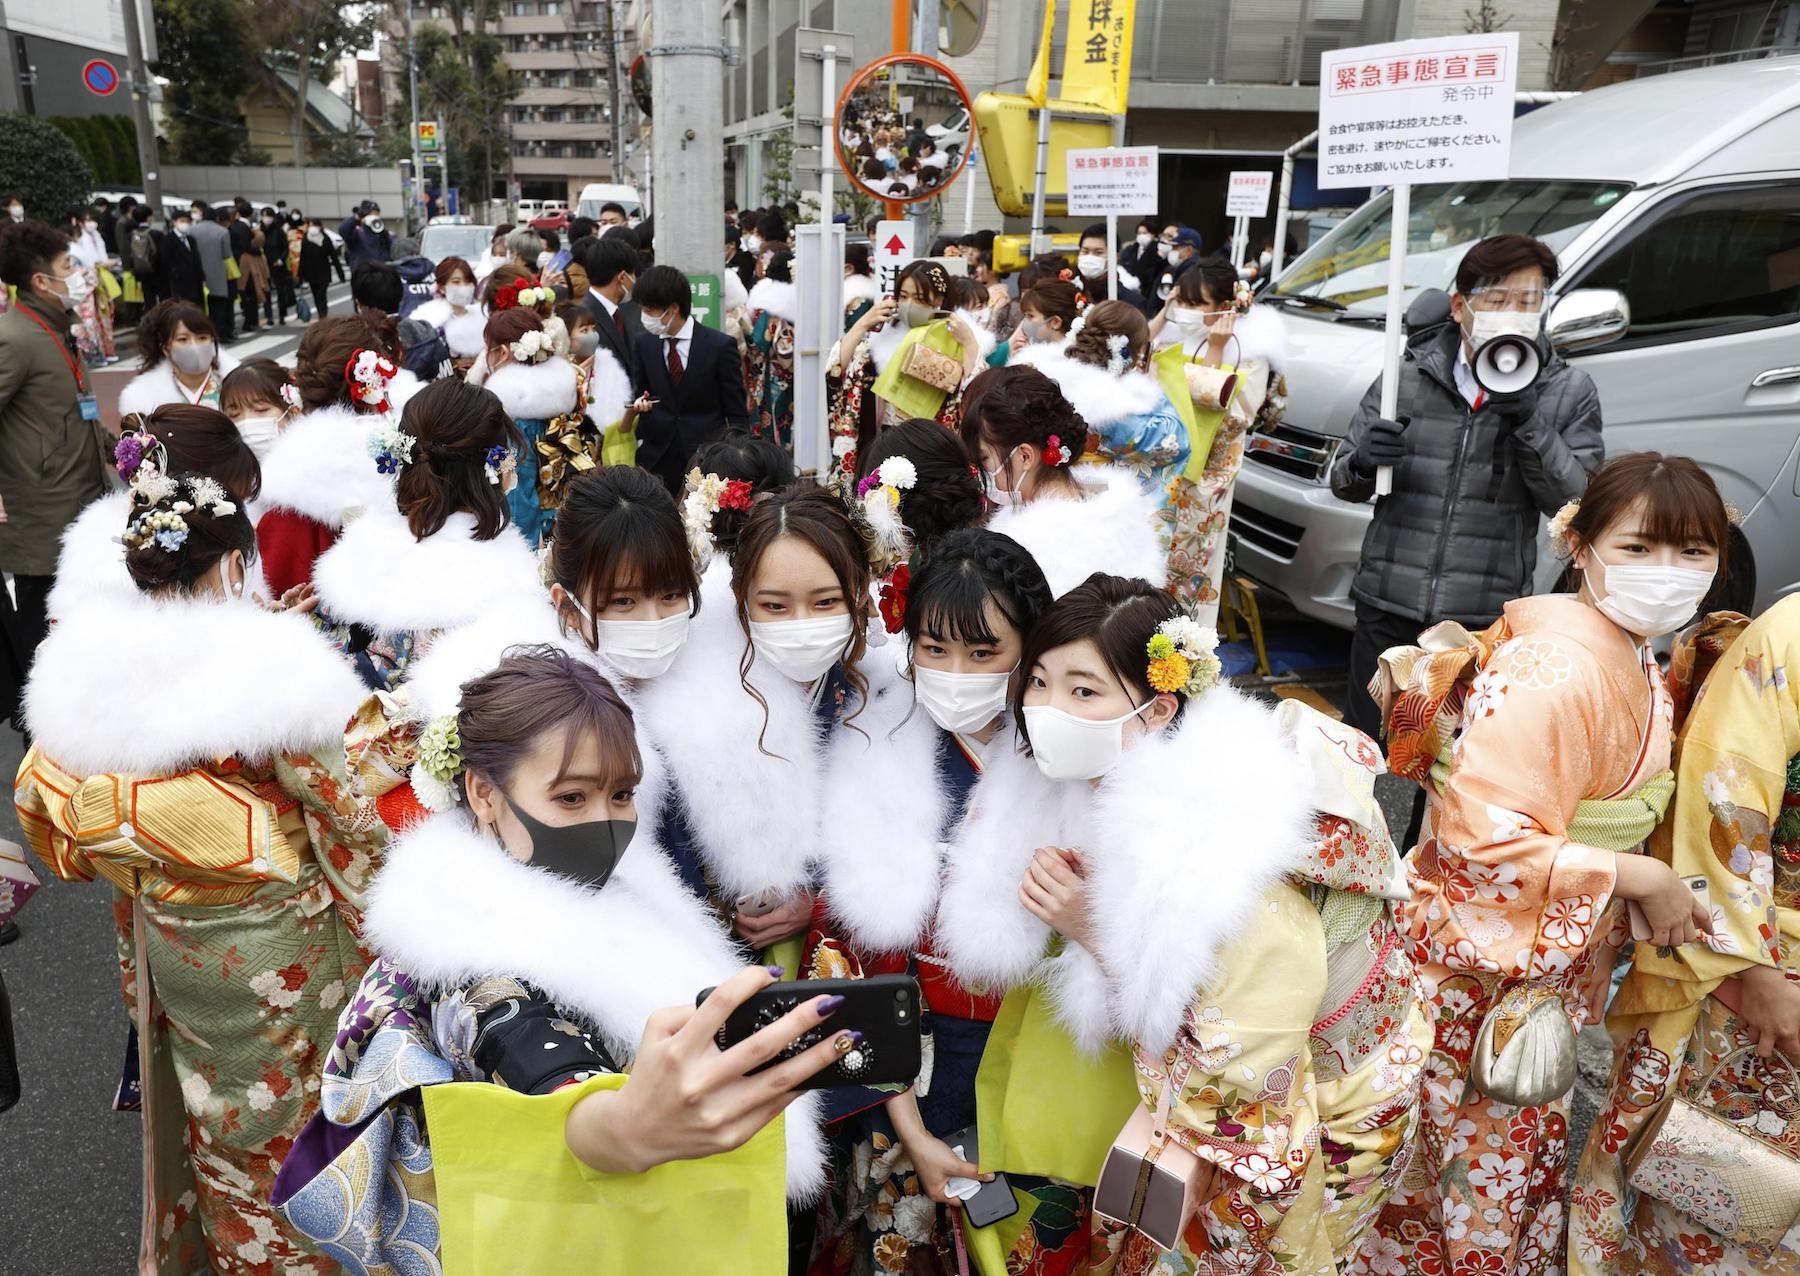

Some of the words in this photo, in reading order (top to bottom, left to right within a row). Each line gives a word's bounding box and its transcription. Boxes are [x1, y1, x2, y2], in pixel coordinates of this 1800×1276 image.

[1336, 54, 1499, 90] 緊急事態宣言
[1442, 85, 1494, 102] 発令中
